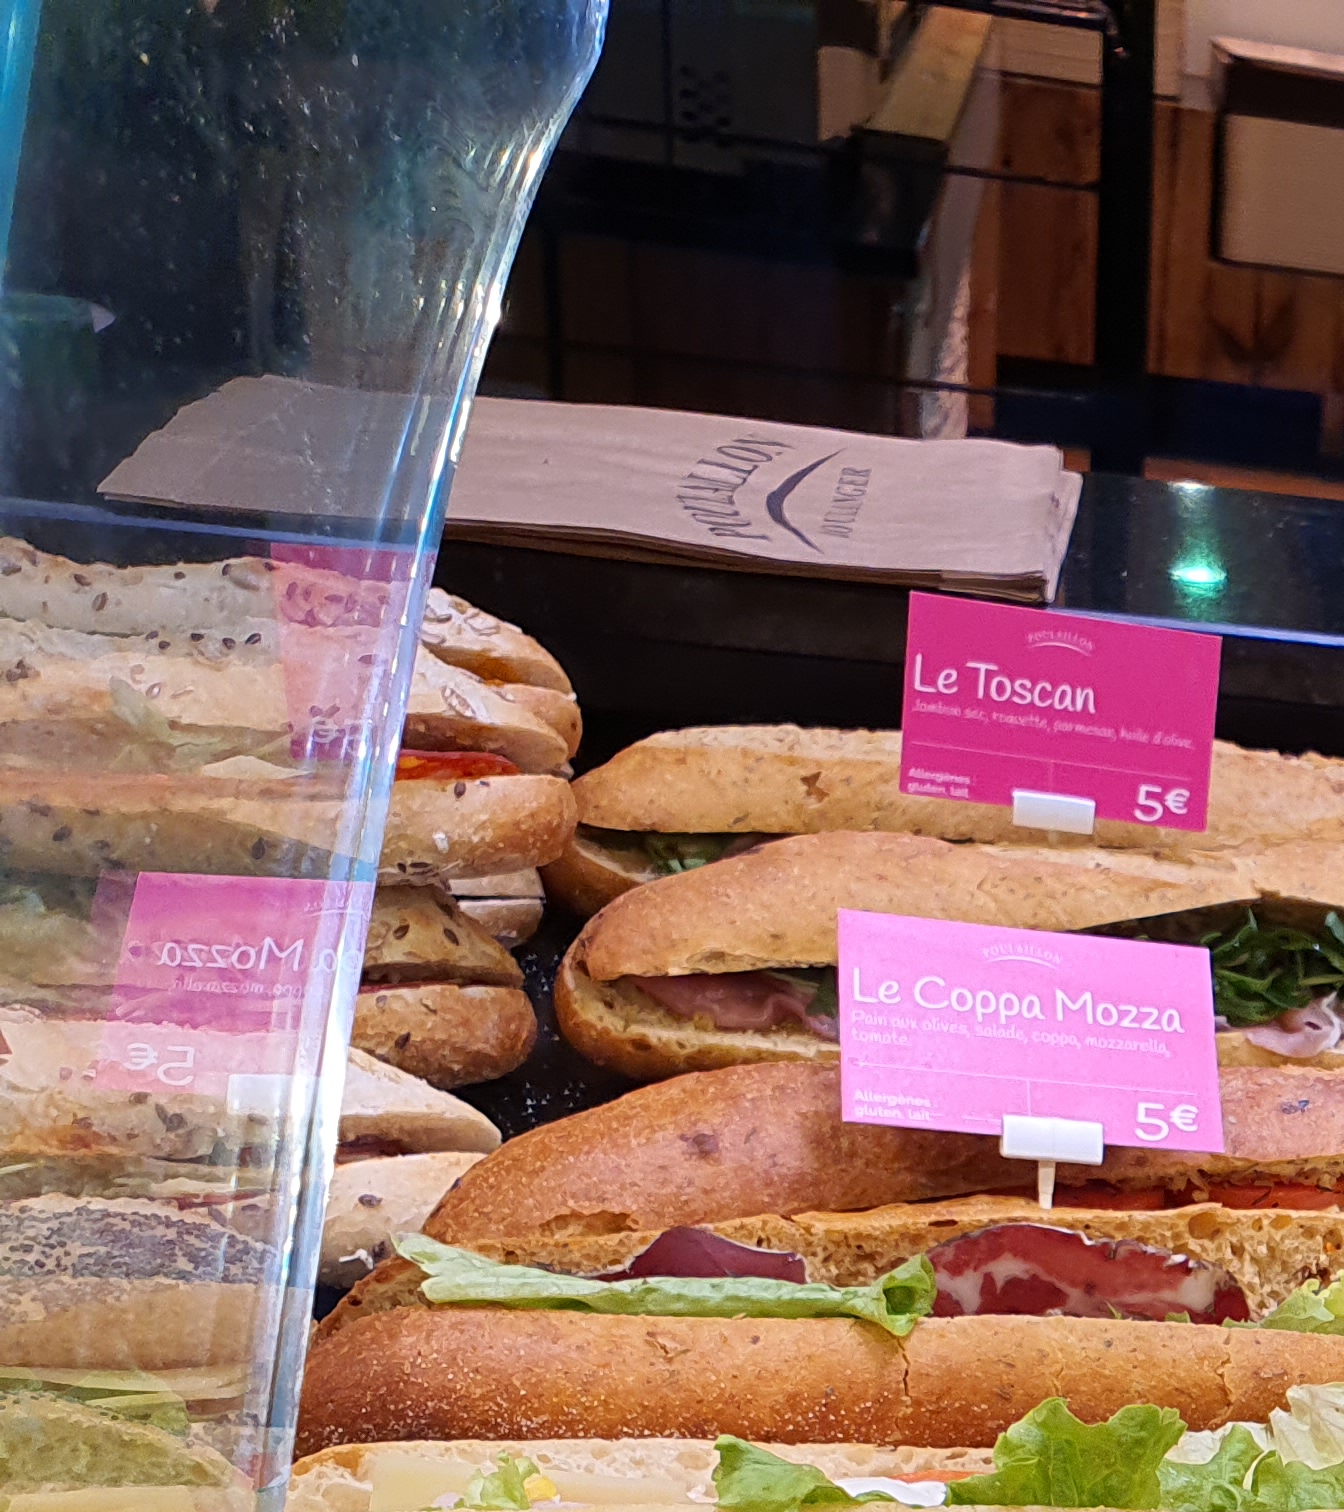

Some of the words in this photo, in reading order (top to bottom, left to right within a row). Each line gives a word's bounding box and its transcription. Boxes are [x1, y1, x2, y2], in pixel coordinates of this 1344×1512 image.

[914, 653, 959, 696] Le
[965, 660, 1097, 715] Toscan
[1134, 784, 1191, 823] 5€
[852, 967, 902, 1005] Le
[914, 976, 1047, 1024] Coppa
[1054, 987, 1186, 1035] Mozza
[851, 1010, 888, 1027] Pain
[892, 1018, 918, 1030] aux
[922, 1016, 971, 1039] olives,
[974, 1023, 1029, 1045] salade,
[1032, 1030, 1082, 1050] coppa,
[1085, 1035, 1172, 1059] mozzarella,
[1134, 1101, 1200, 1141] 5€
